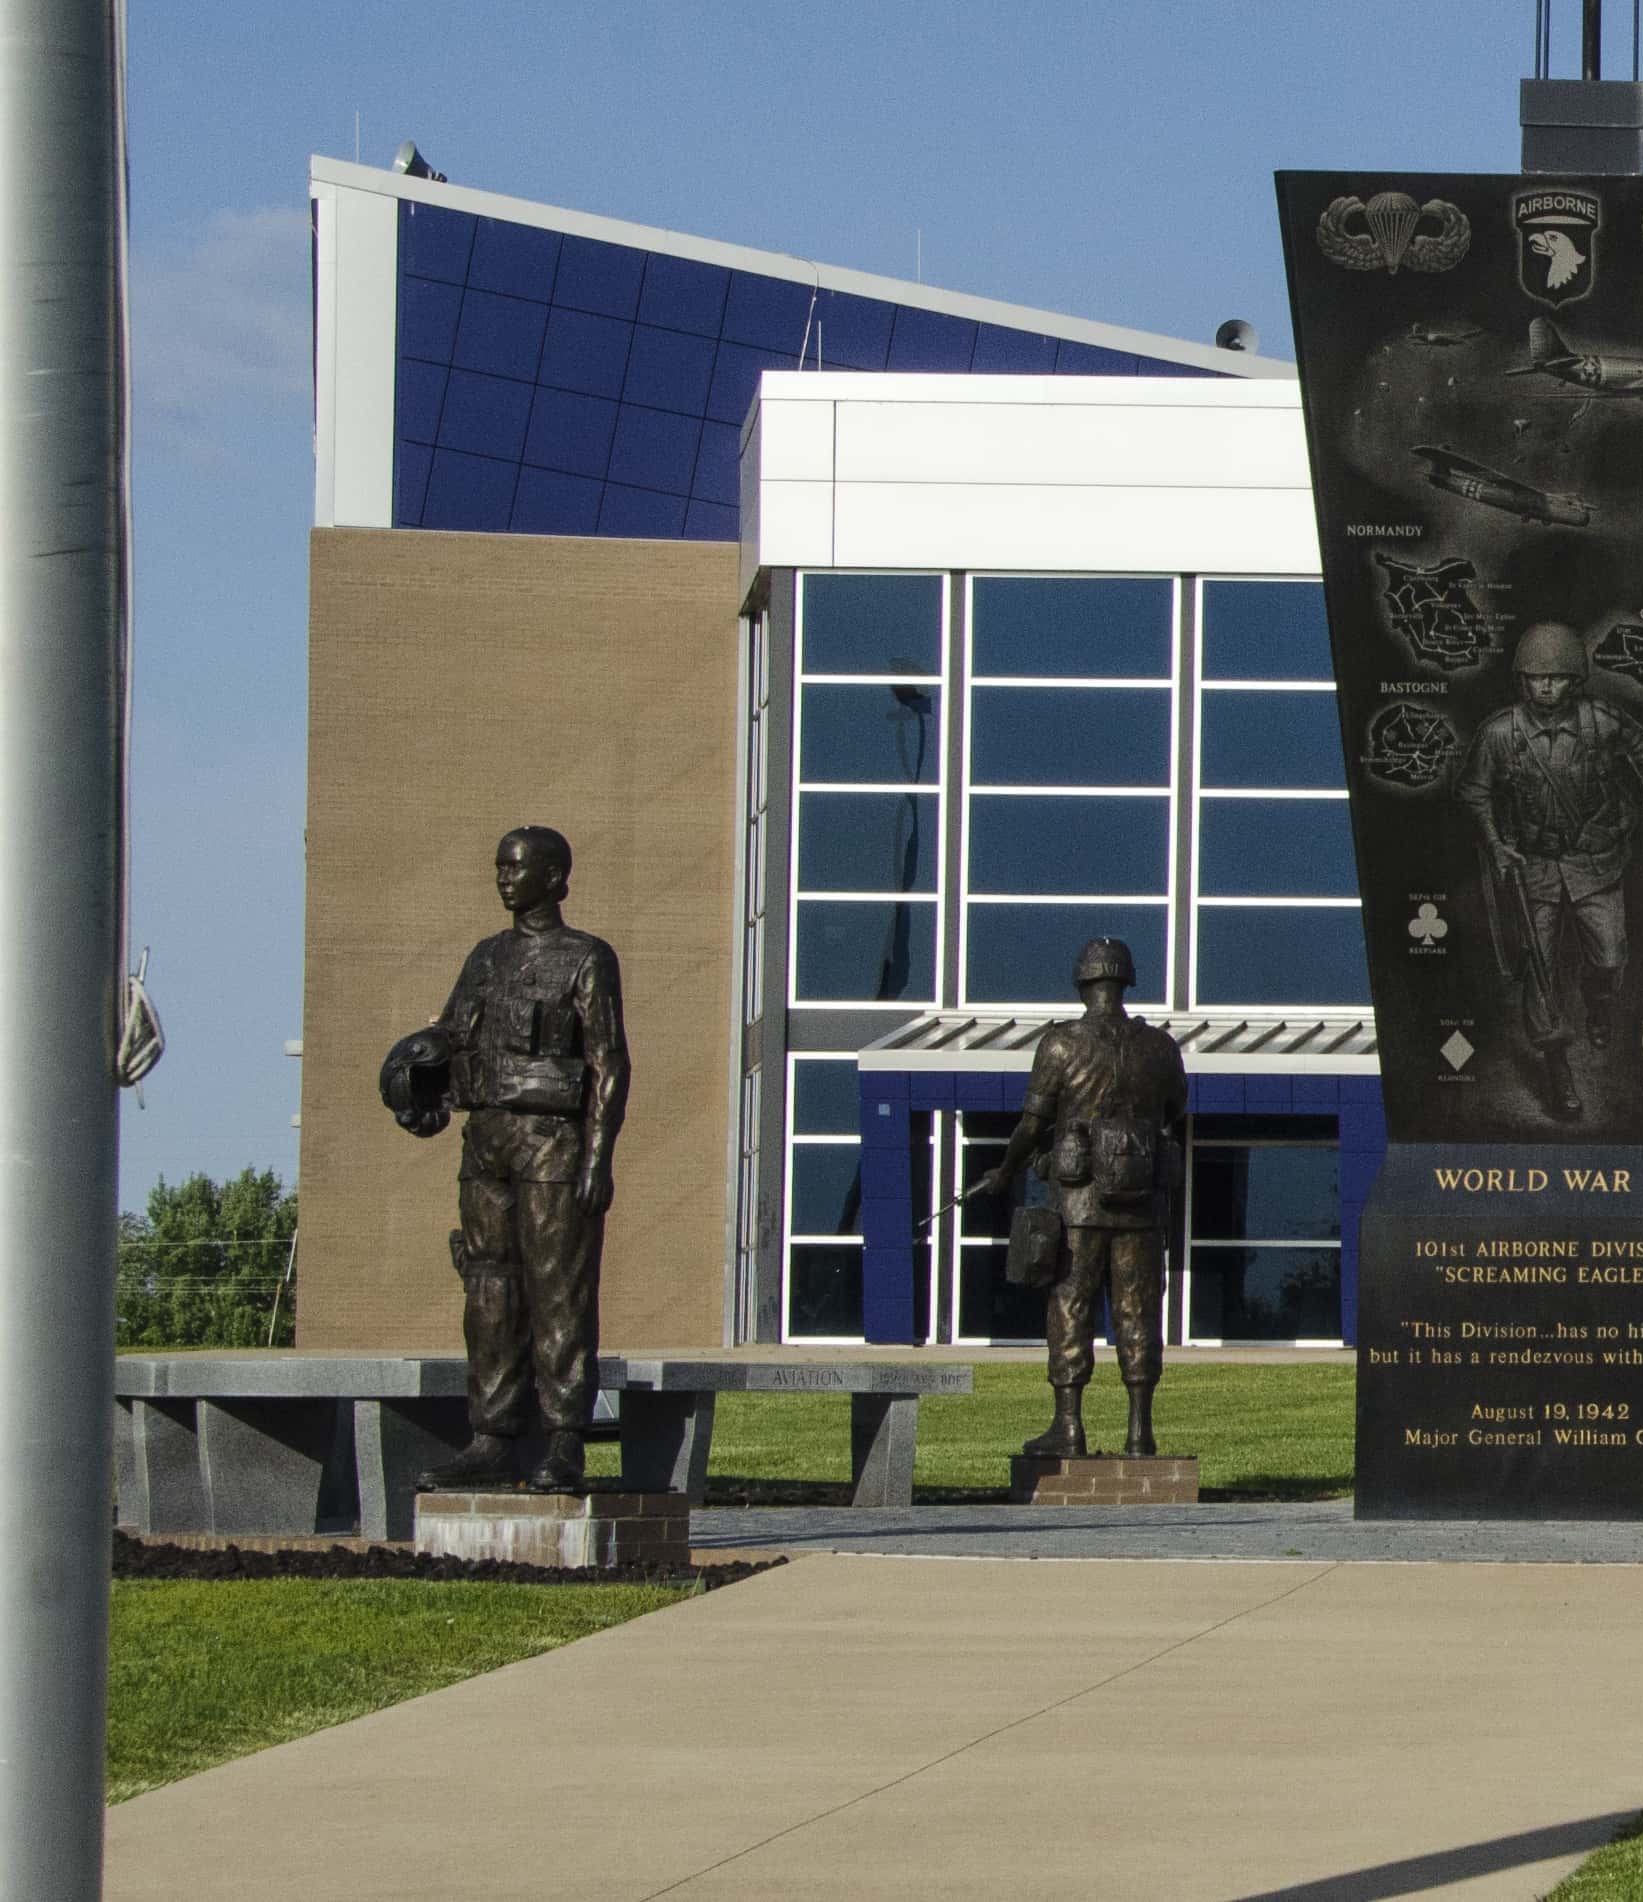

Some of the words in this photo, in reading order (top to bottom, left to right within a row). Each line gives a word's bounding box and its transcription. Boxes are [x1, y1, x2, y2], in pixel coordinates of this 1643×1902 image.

[1518, 196, 1597, 219] AIRBORNE
[1346, 524, 1424, 537] NORMANDY
[1380, 682, 1449, 694] BASTOGNE
[1435, 1169, 1549, 1192] WORLD
[1563, 1170, 1631, 1193] WAR
[1416, 1241, 1466, 1257] 101st
[1476, 1241, 1580, 1257] AIRBORNE
[1436, 1266, 1567, 1283] "SCREAMING
[1401, 1322, 1451, 1339] "This
[1597, 1327, 1619, 1339] no
[1370, 1348, 1399, 1364] but
[1409, 1348, 1421, 1364] it
[1432, 1348, 1462, 1364] has
[1471, 1352, 1480, 1364] a
[1490, 1348, 1594, 1364] rendezvous
[1603, 1348, 1643, 1364] with
[772, 1370, 844, 1386] AVIATION
[1472, 1404, 1535, 1423] August
[1578, 1403, 1630, 1420] 1942
[1405, 1429, 1459, 1449] Major
[1469, 1429, 1541, 1446] General
[1554, 1429, 1627, 1446] William
